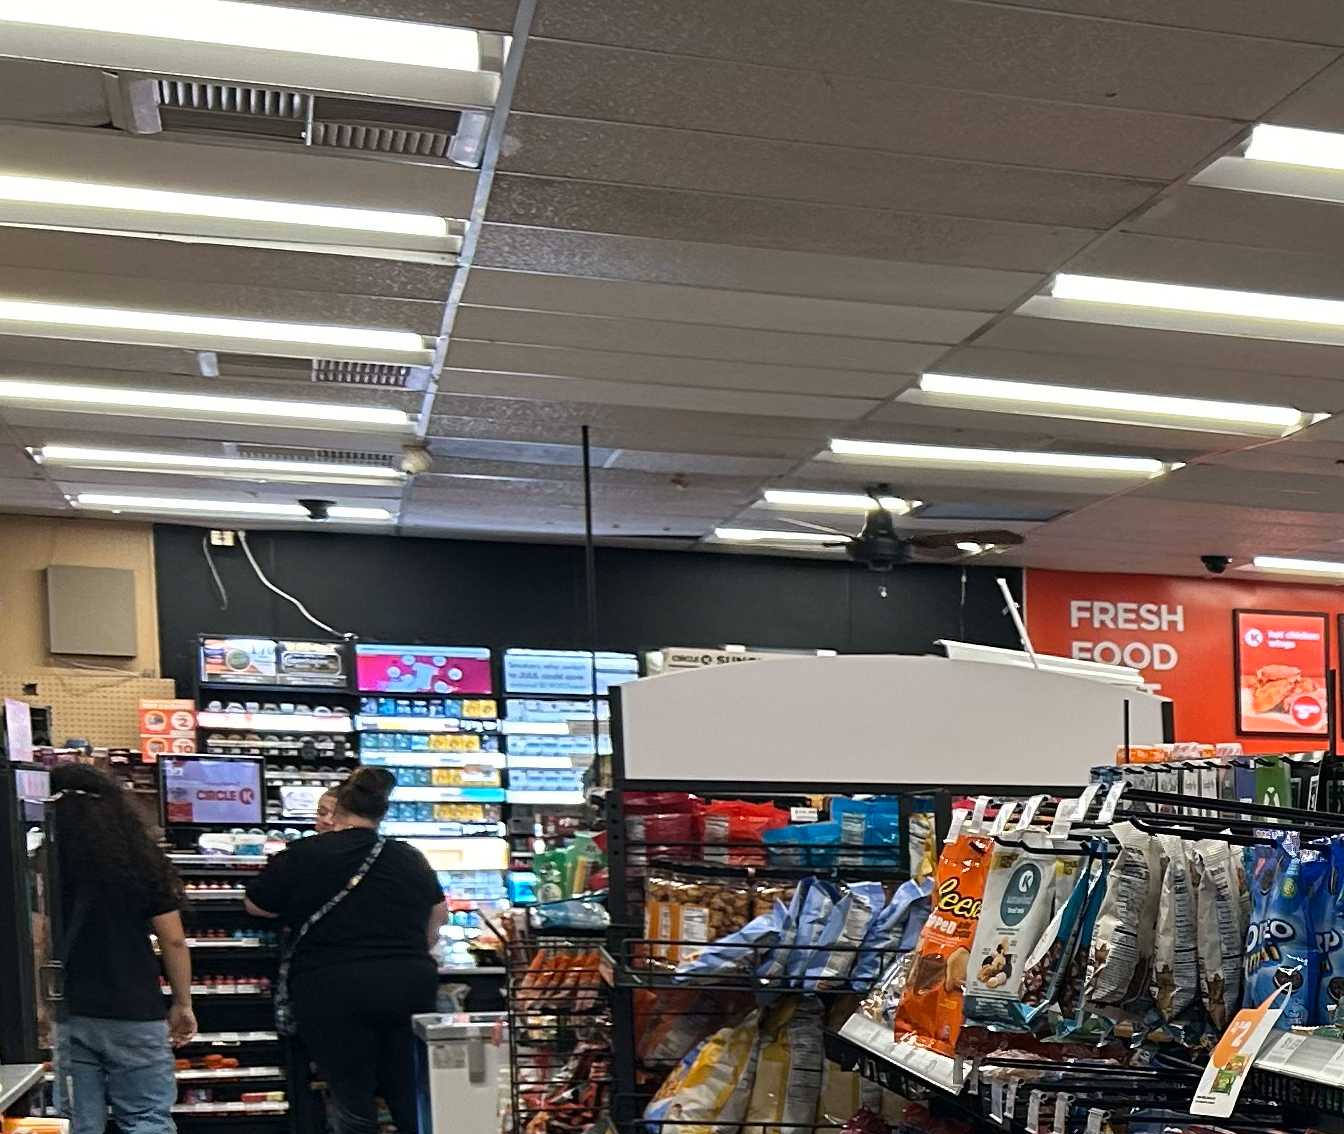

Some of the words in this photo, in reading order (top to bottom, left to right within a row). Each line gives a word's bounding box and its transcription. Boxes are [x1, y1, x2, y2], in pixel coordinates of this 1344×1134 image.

[1070, 600, 1185, 633] FRESH
[1071, 640, 1178, 671] FOOD
[196, 789, 237, 802] CIRCLE
